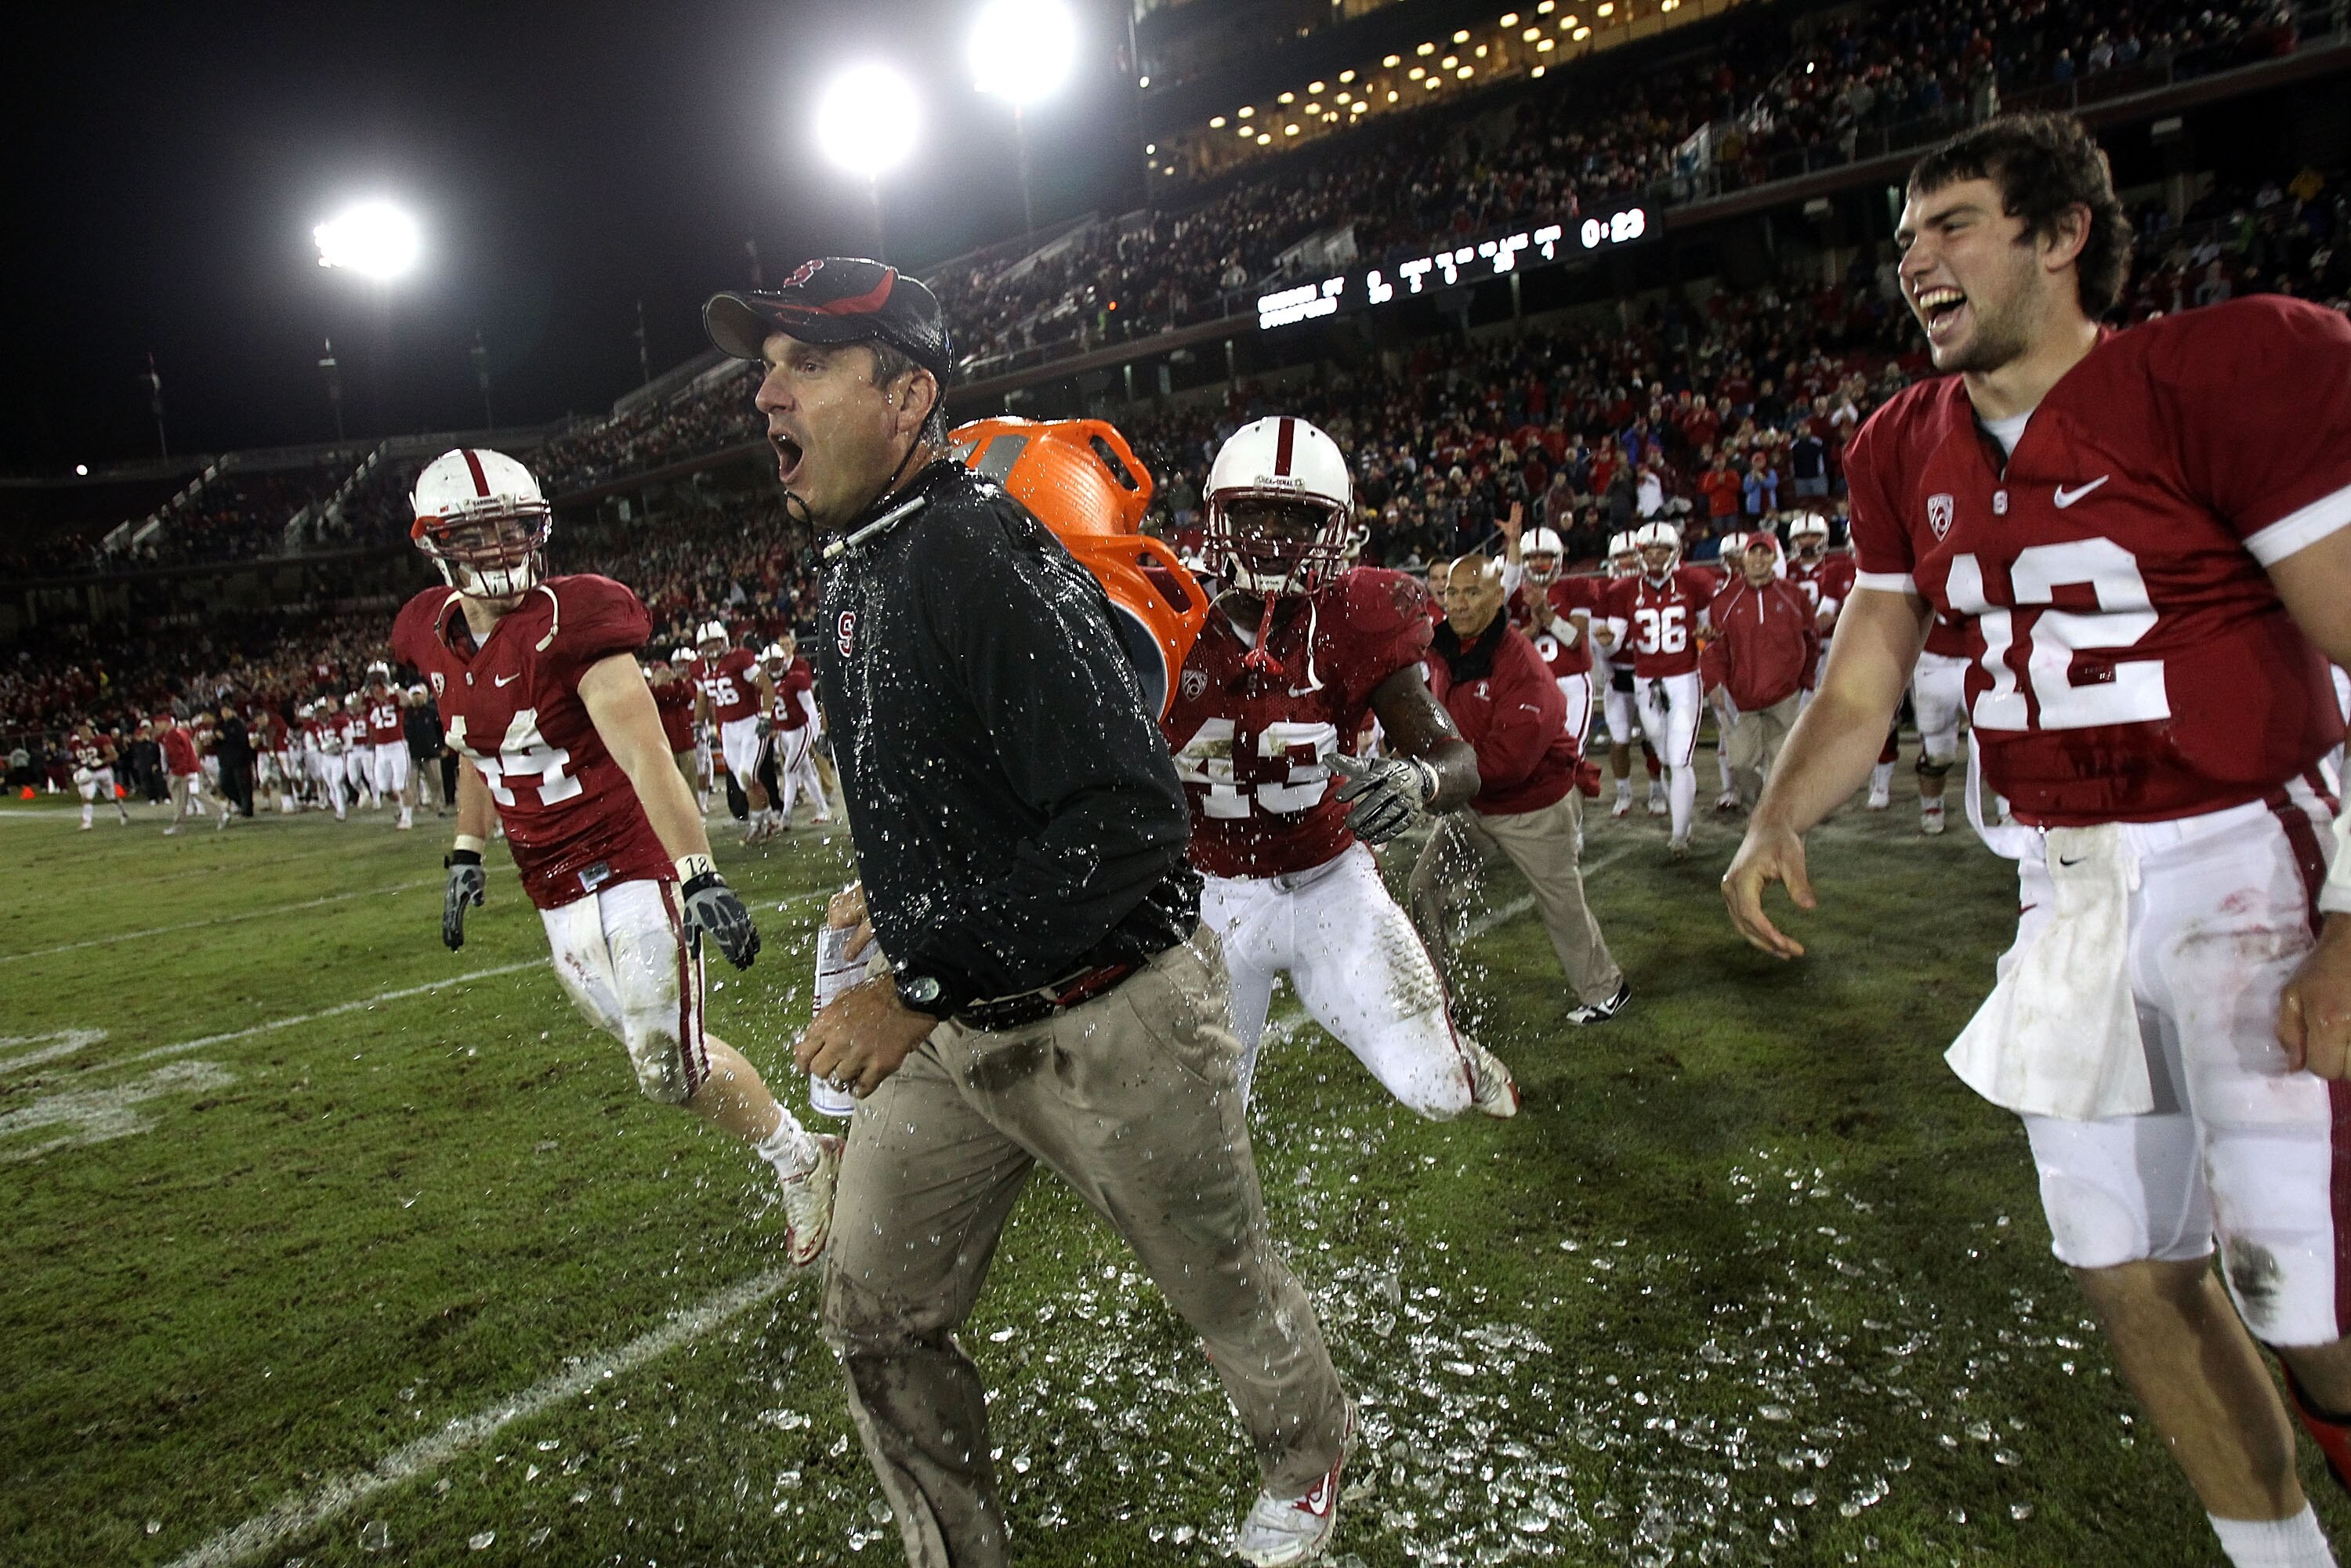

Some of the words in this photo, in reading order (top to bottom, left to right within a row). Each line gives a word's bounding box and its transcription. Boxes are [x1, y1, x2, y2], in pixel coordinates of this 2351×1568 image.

[838, 611, 857, 658] S
[1634, 606, 1687, 655] 36
[1945, 537, 2172, 732] 12
[704, 677, 740, 707] 56
[370, 705, 397, 730] 45
[1174, 716, 1338, 819] 43
